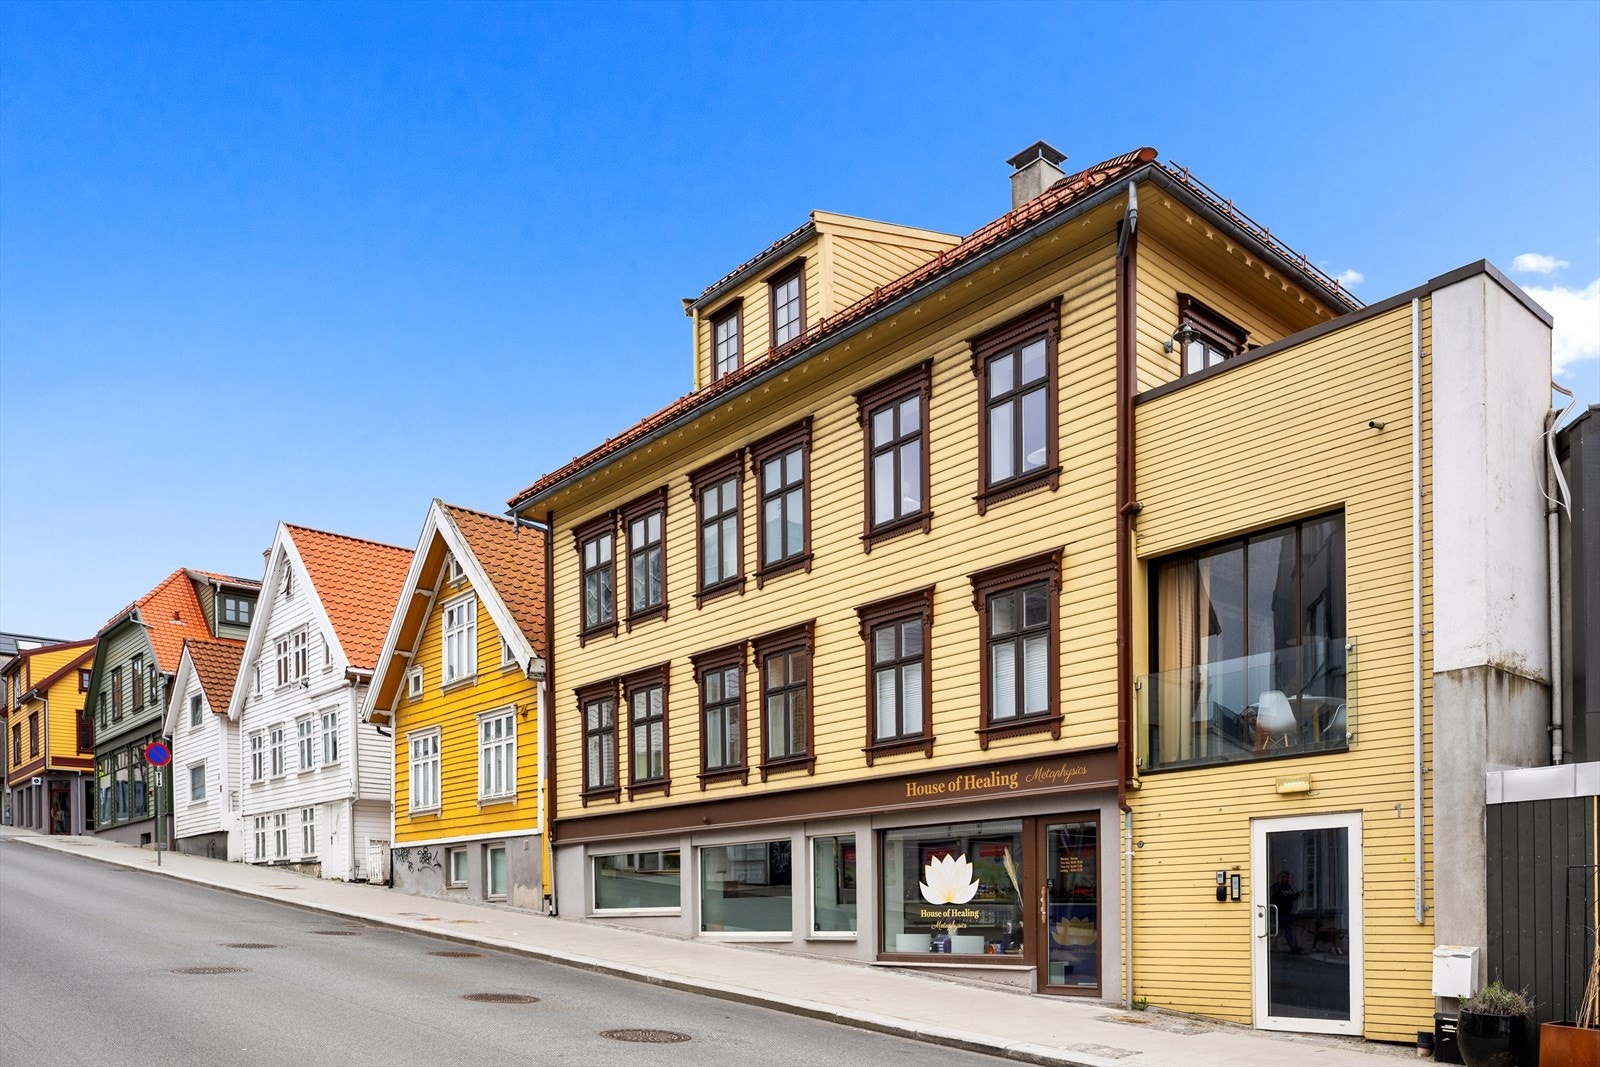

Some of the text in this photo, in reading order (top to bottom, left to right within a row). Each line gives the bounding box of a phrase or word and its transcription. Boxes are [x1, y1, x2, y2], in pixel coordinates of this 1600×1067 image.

[906, 763, 1088, 797] House of Healing Metaphysics
[920, 908, 980, 919] House of Healing
